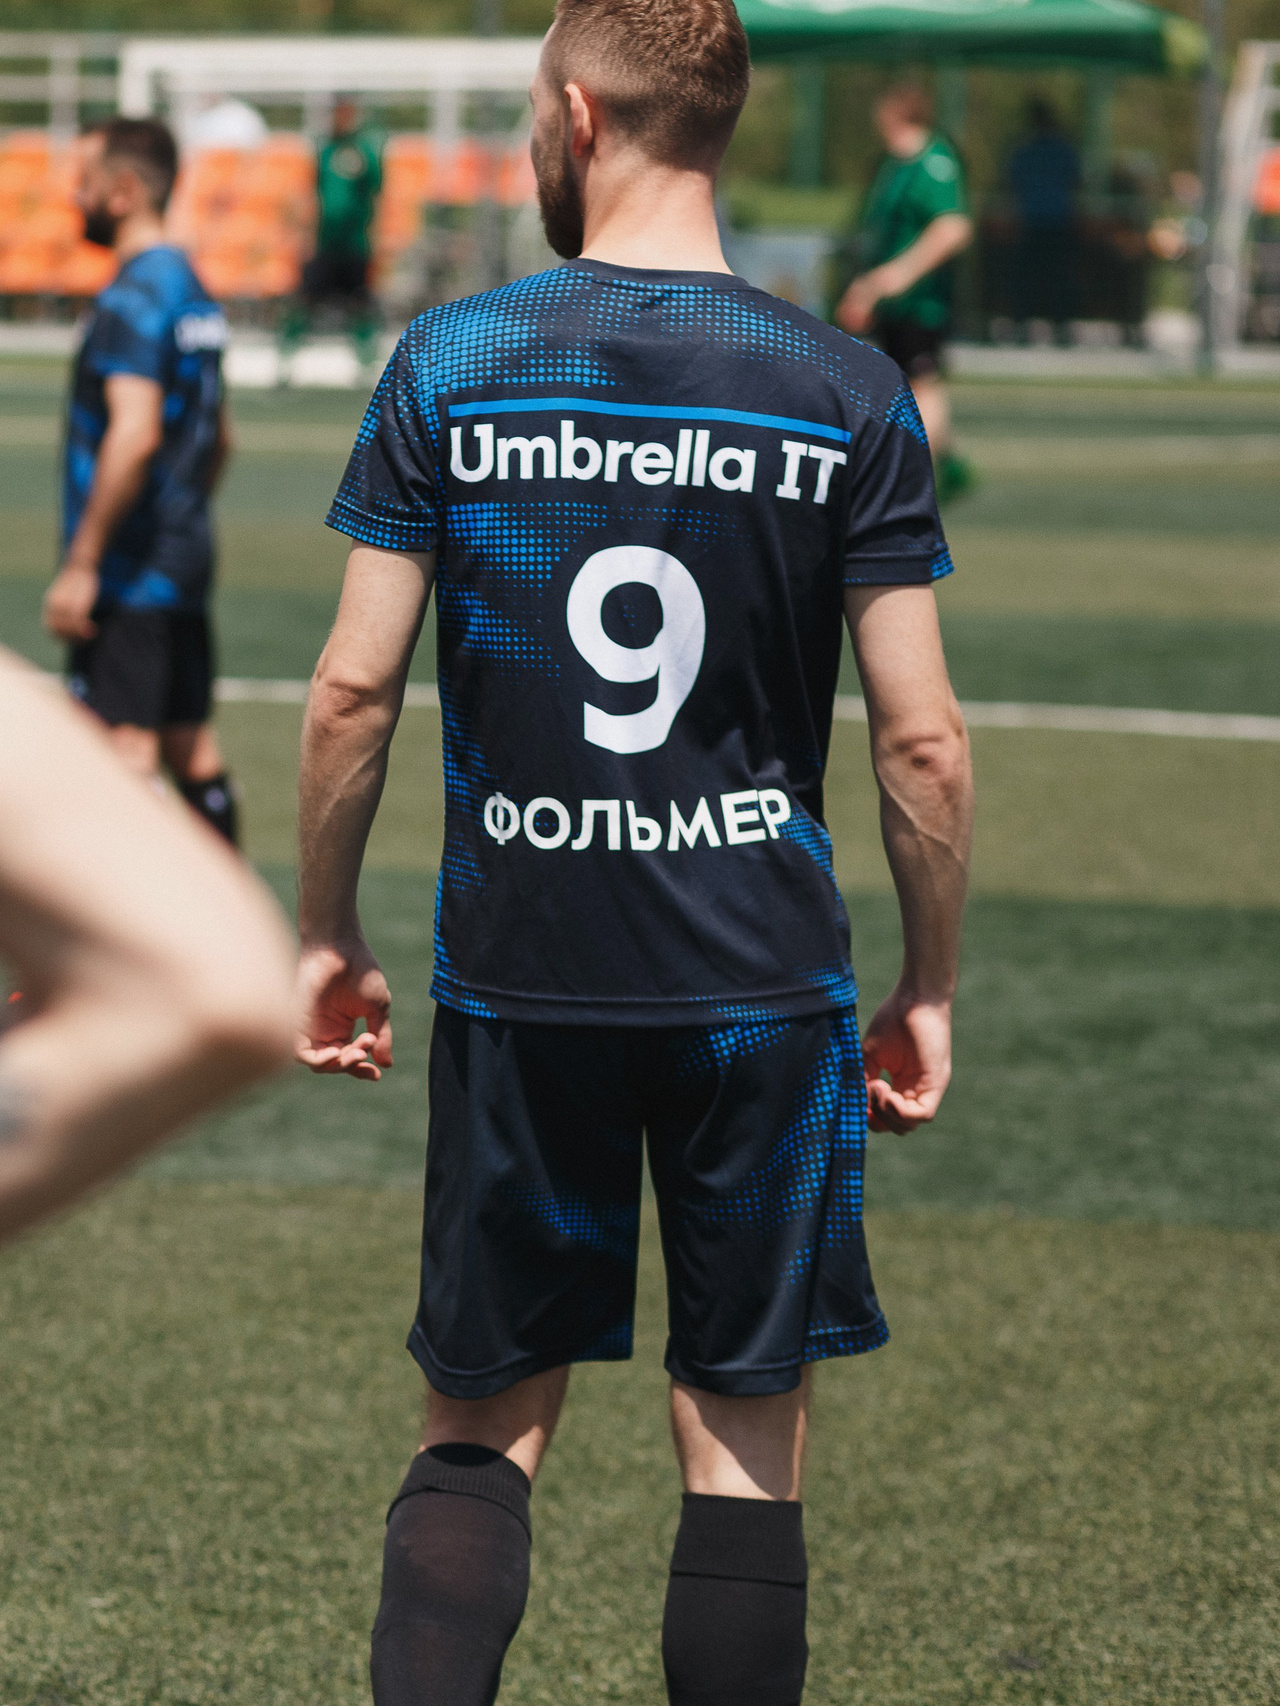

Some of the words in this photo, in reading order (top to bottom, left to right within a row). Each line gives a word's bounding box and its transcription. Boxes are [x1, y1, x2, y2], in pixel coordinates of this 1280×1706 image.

[450, 420, 756, 492] Umbrella
[775, 439, 847, 504] IT
[566, 545, 706, 754] 9
[483, 788, 792, 852] ФОЛЬМЕР
